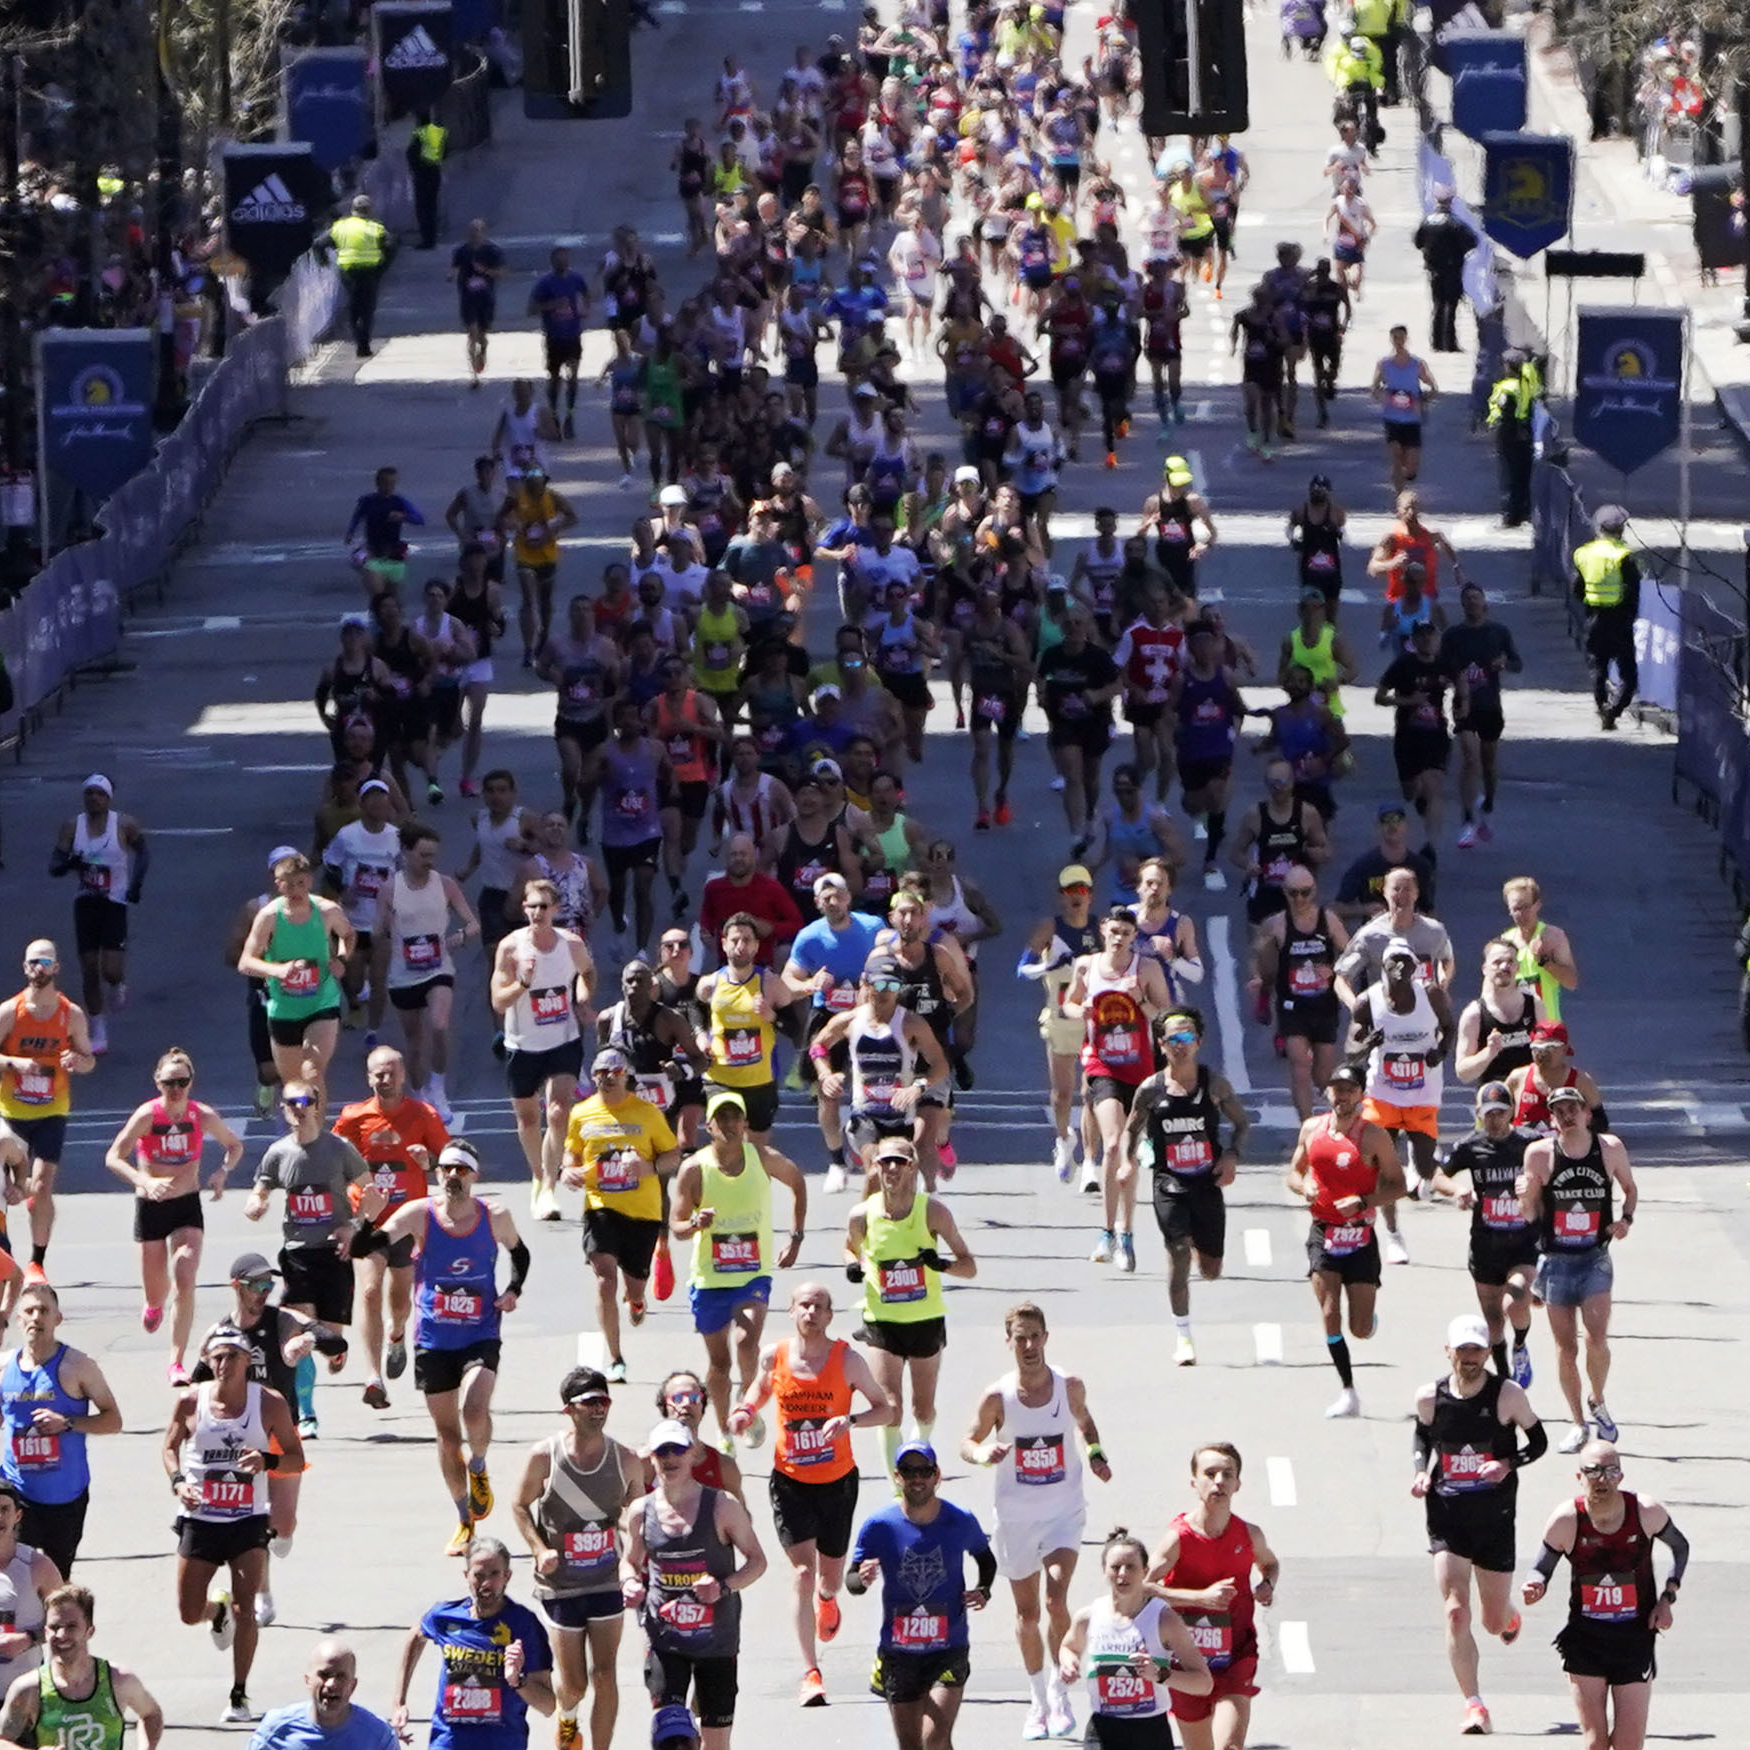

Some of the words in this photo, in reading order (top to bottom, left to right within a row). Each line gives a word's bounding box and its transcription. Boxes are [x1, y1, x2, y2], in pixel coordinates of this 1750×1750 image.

[444, 1296, 476, 1314] 1925
[212, 1483, 244, 1503] 1171
[573, 1532, 607, 1552] 3931
[1593, 1587, 1623, 1606] 719
[903, 1617, 940, 1638] 1208
[1108, 1678, 1144, 1697] 2524
